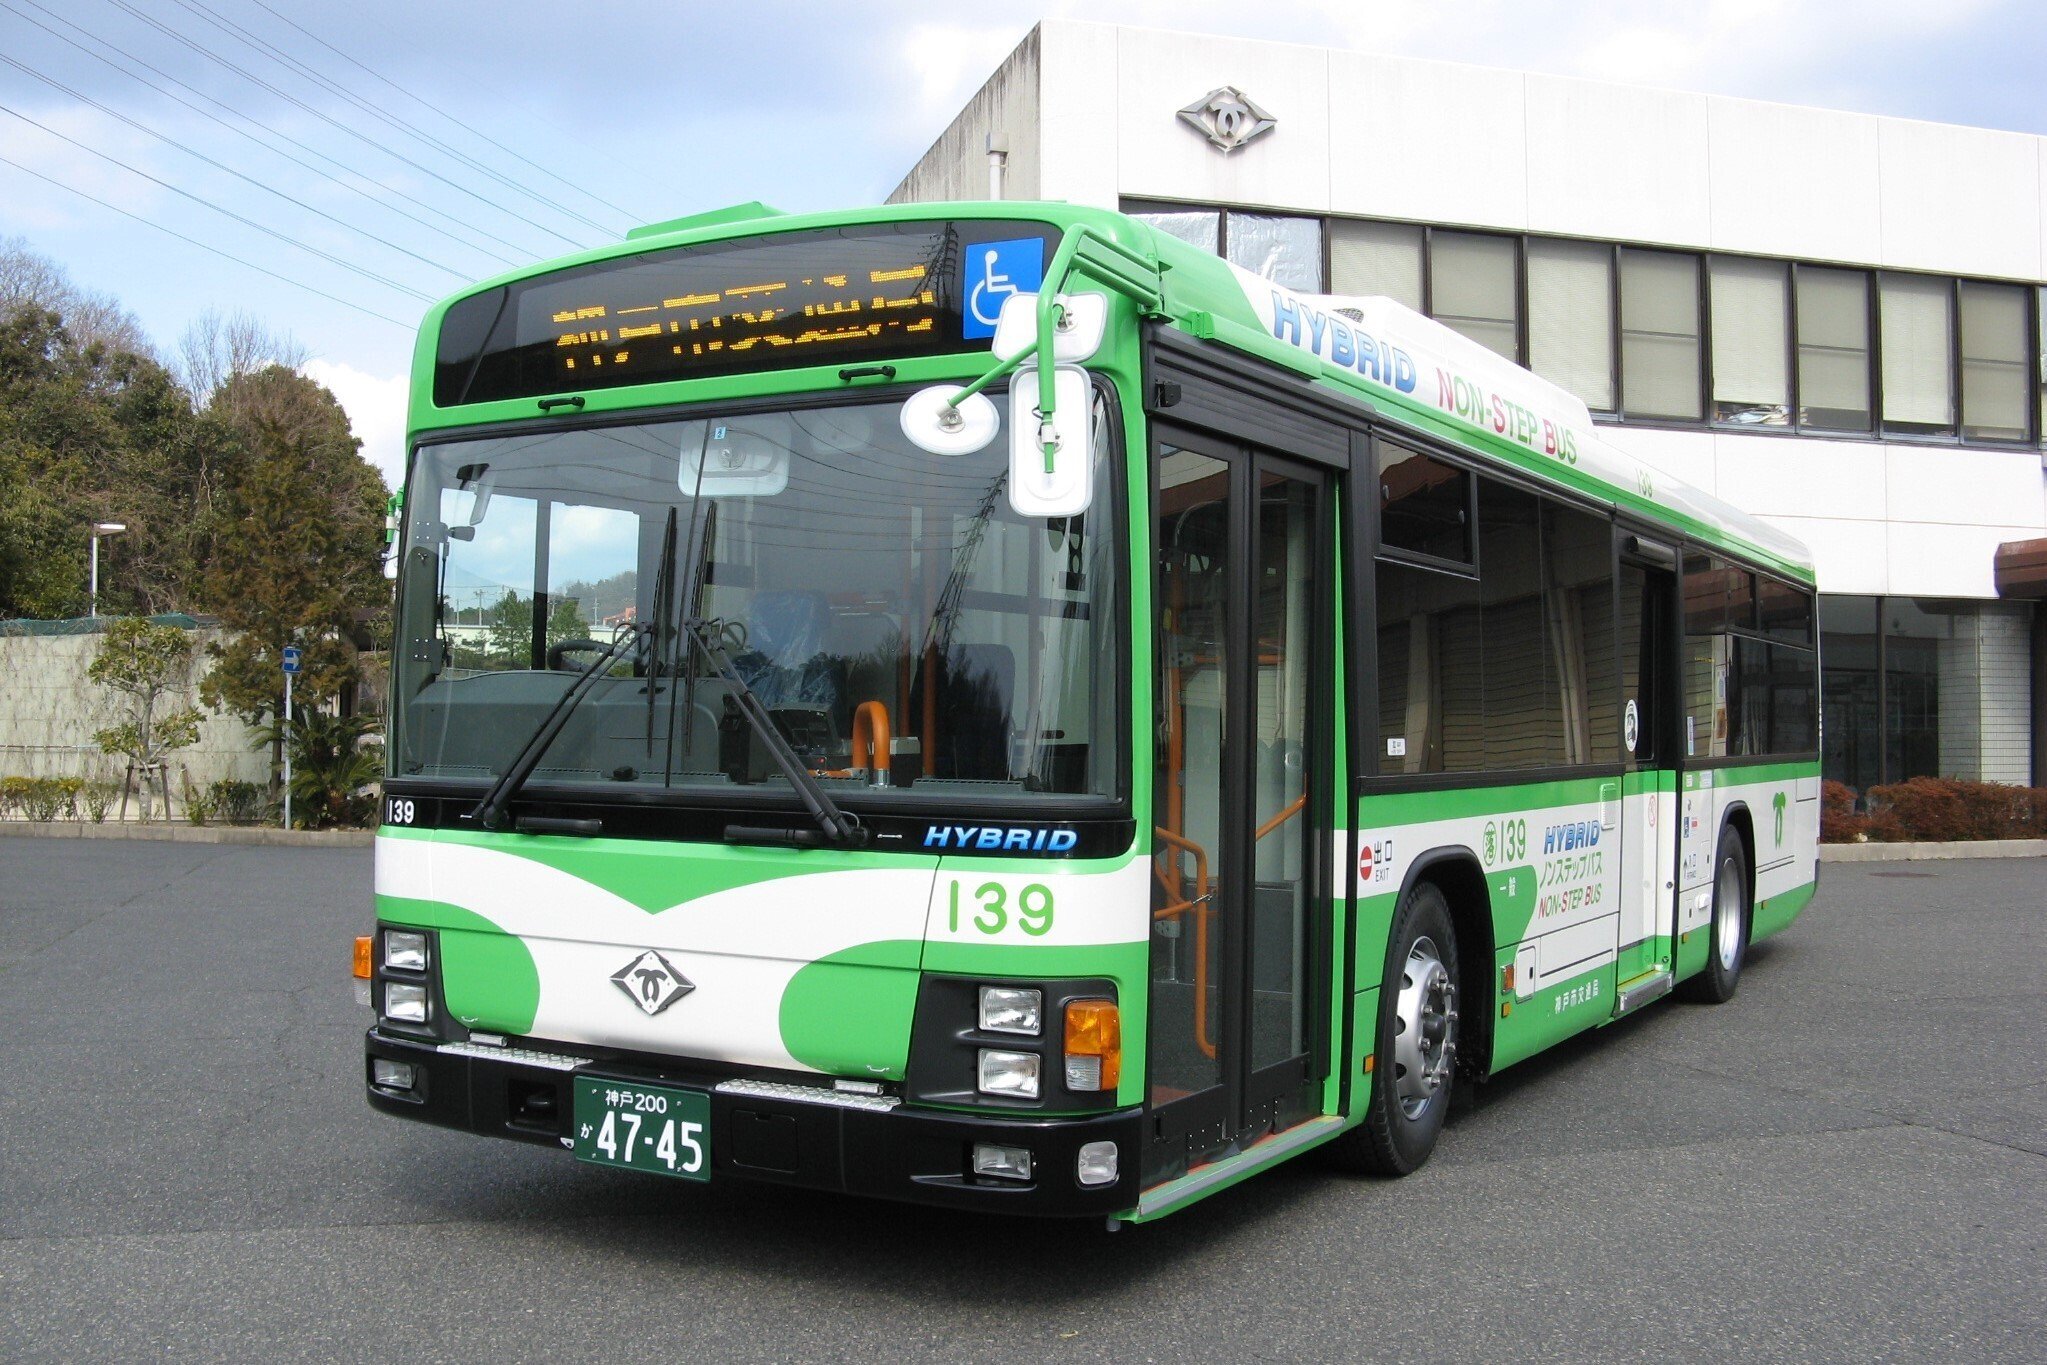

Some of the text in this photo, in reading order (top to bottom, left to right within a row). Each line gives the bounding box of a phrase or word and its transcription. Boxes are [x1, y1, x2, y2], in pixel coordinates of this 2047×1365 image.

[1272, 290, 1417, 393] HYBRID
[1437, 368, 1577, 464] NON-STEP BUS
[1634, 467, 1652, 497] 139
[389, 800, 414, 823] 139
[923, 826, 1078, 850] HYBRID
[1374, 840, 1392, 864] 出口
[1501, 818, 1525, 863] 139
[1544, 820, 1599, 854] HYBRID
[1375, 868, 1389, 882] EXIT
[1540, 852, 1601, 888] ノンステップバス
[950, 880, 1054, 936] 139
[1539, 883, 1601, 919] NON-STEP BUS
[580, 1110, 703, 1173] か 47-45
